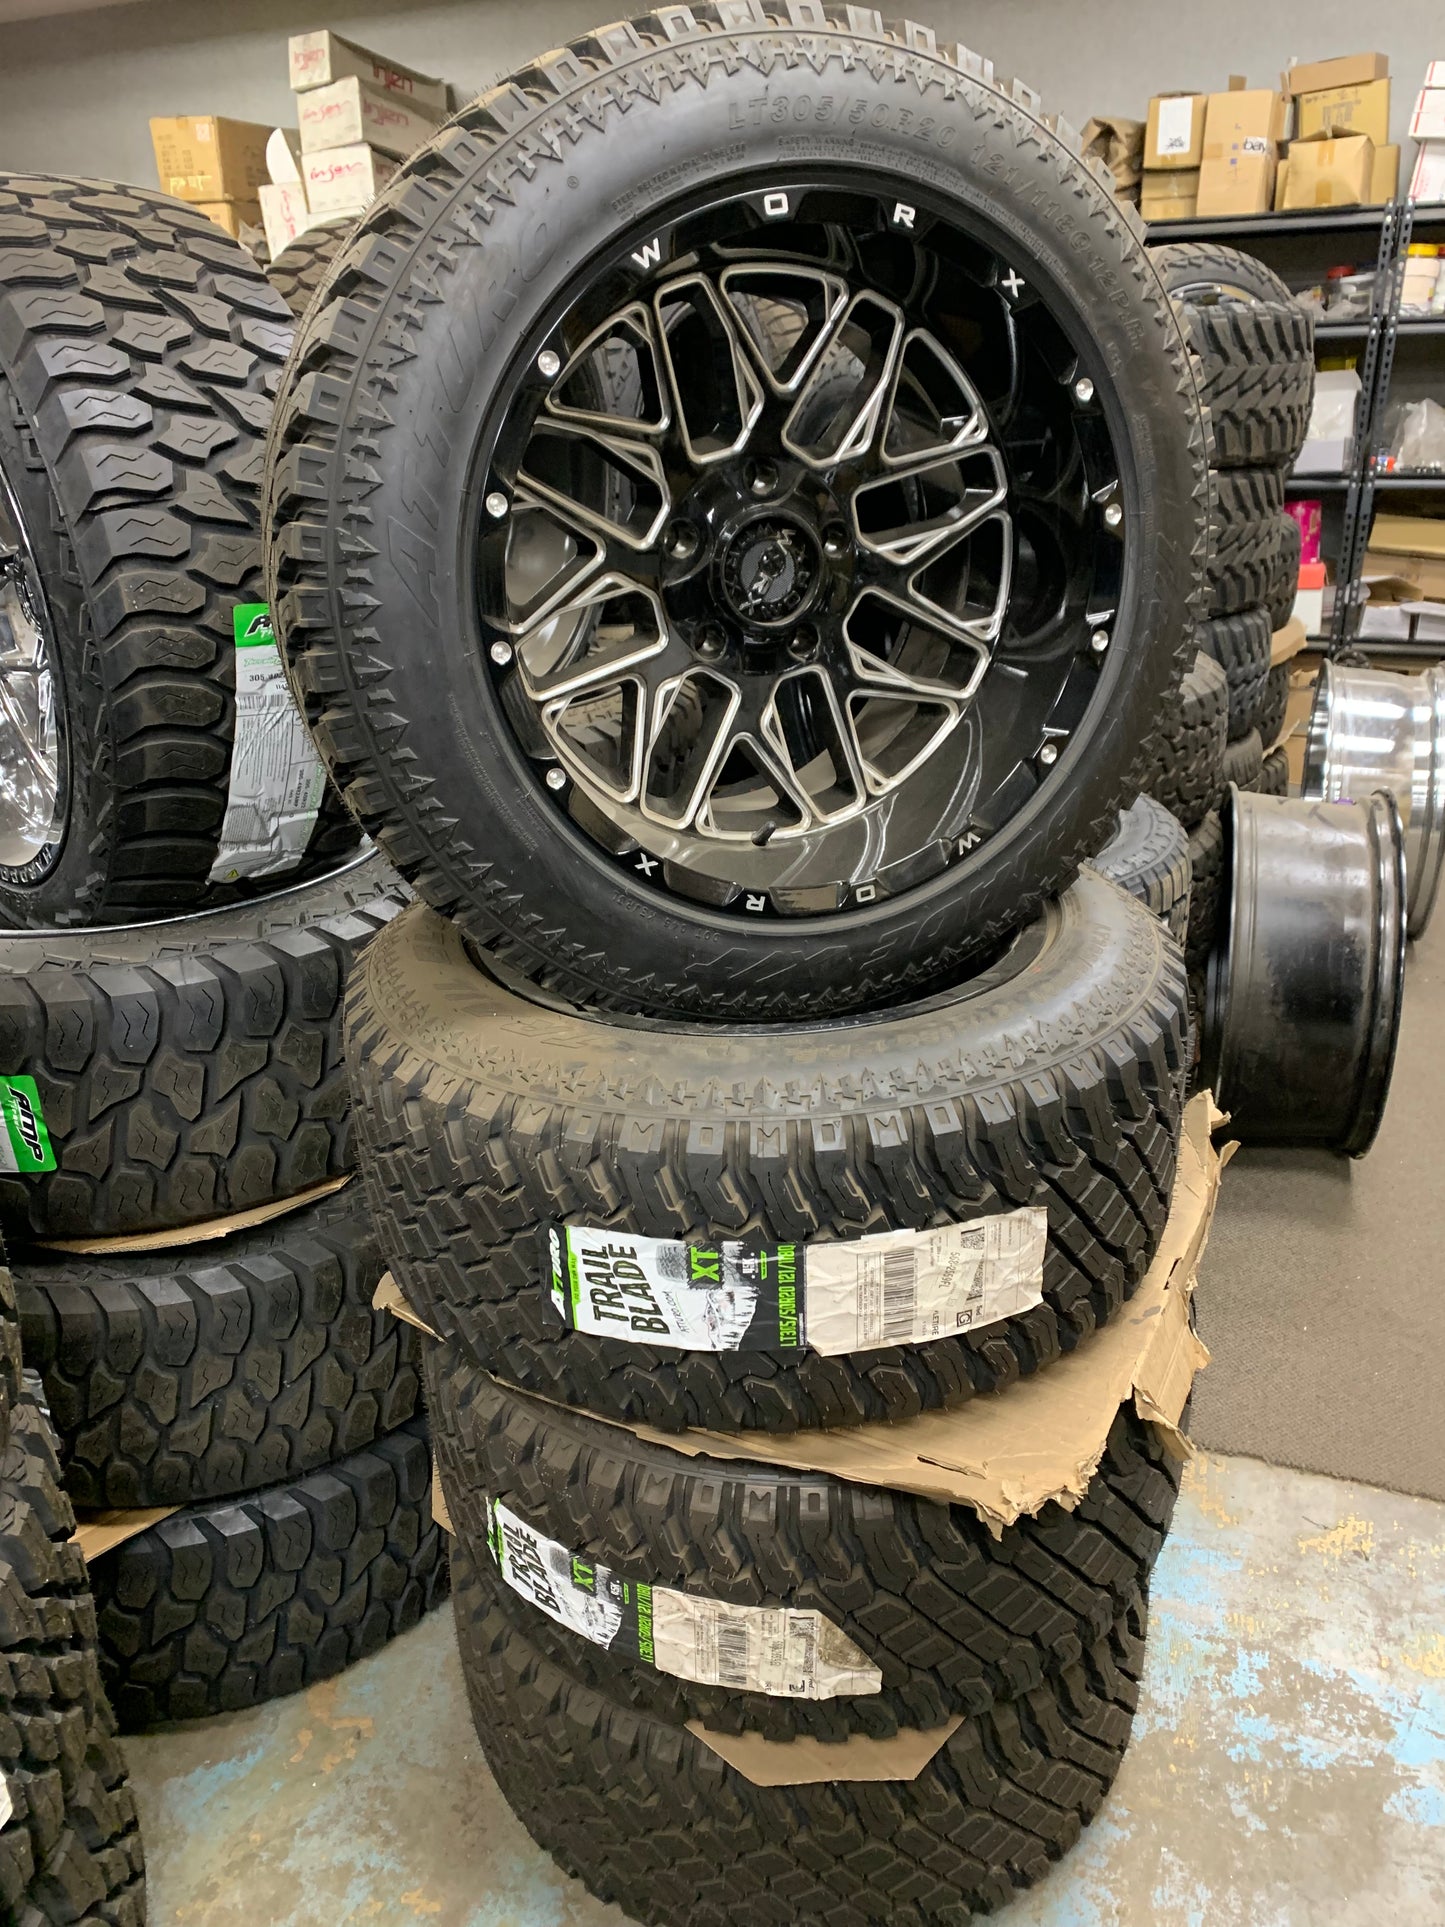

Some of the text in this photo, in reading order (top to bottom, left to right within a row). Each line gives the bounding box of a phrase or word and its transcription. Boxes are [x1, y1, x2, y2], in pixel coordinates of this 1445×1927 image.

[581, 1246, 630, 1322] TRAIL
[608, 1243, 670, 1334] BLADE
[690, 1246, 720, 1281] XT
[778, 1285, 797, 1347] LT305/50R20
[503, 1523, 534, 1591] TRAIL
[516, 1527, 562, 1614] BLADE
[572, 1557, 594, 1592] XT
